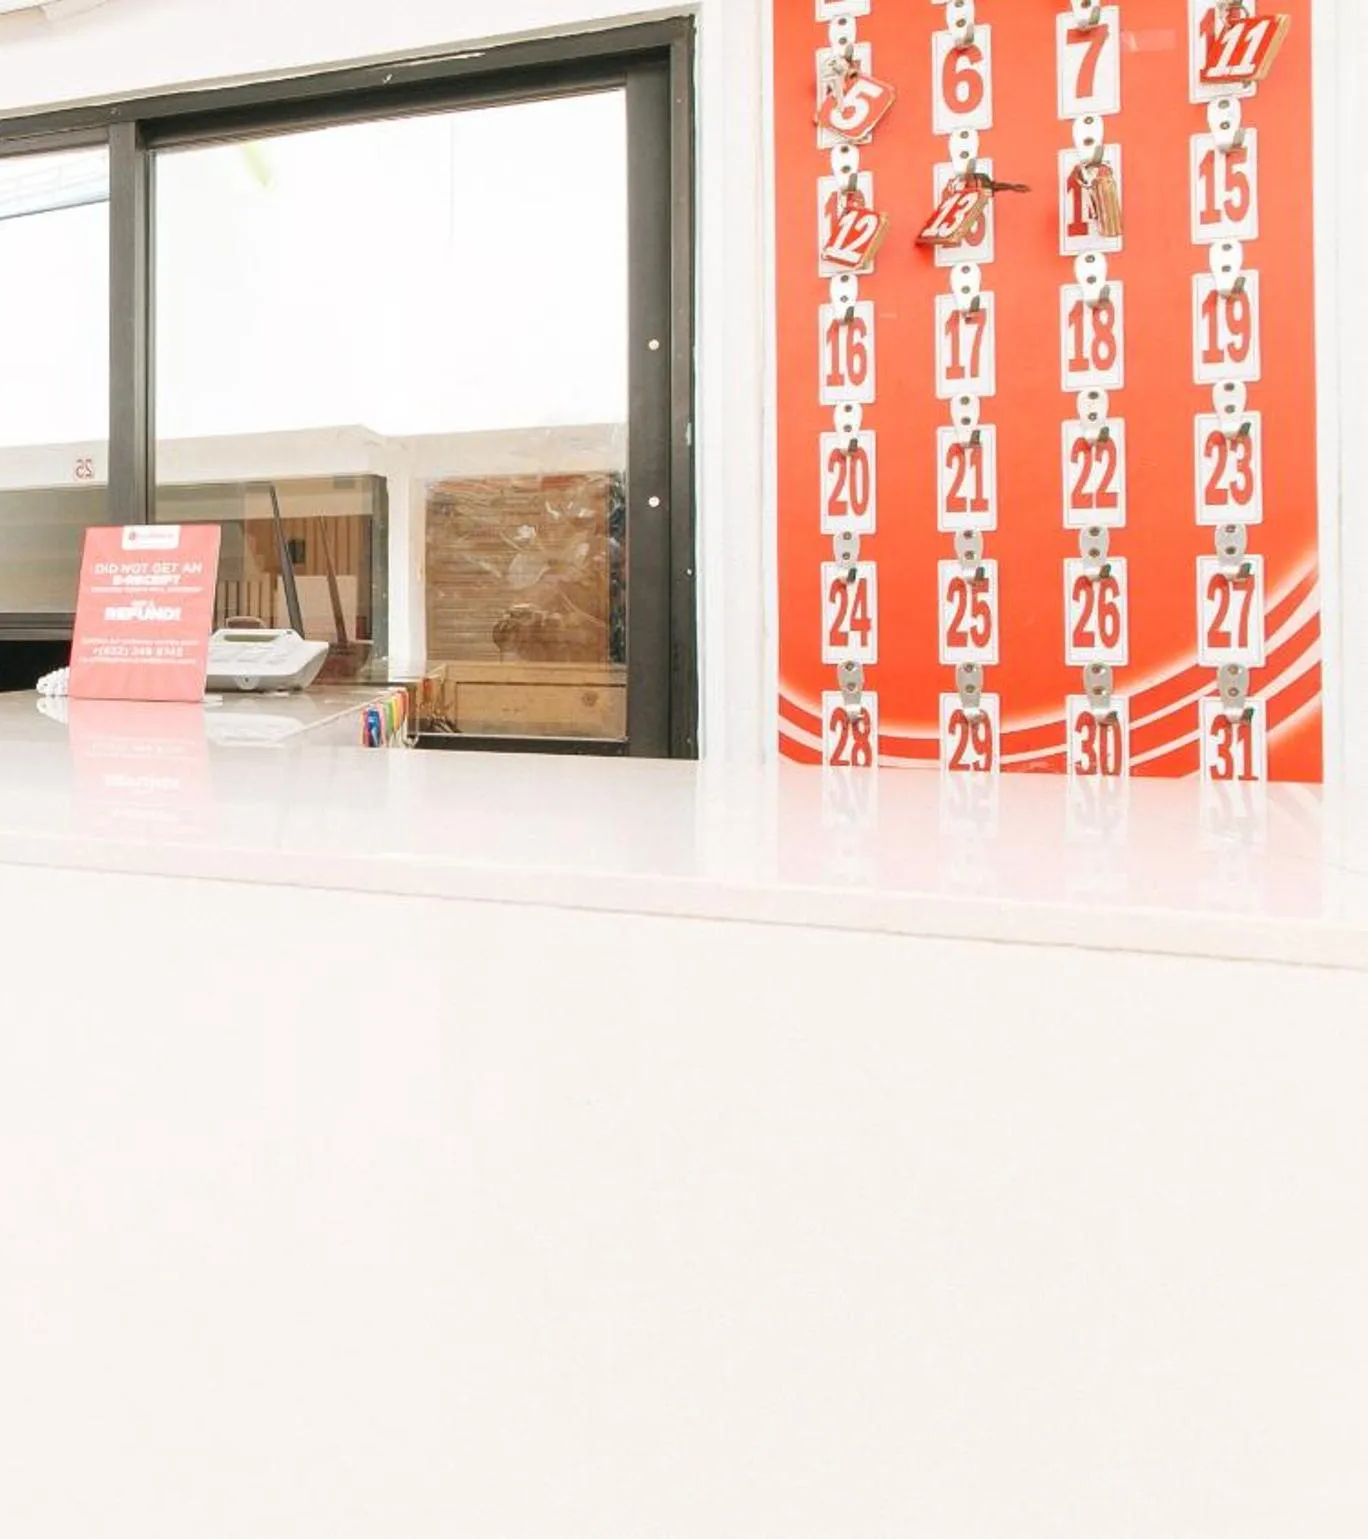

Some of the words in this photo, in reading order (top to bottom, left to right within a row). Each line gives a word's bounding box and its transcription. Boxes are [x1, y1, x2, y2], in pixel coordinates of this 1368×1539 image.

[941, 45, 984, 114] 6
[1066, 24, 1109, 99] 7
[1206, 18, 1271, 78] 11
[828, 78, 884, 130] 5
[920, 189, 979, 238] 13
[1199, 147, 1250, 225] 15
[824, 209, 879, 264] 12
[825, 318, 868, 387] 16
[944, 309, 987, 380] 17
[1069, 301, 1117, 372] 18
[1202, 290, 1251, 364] 19
[827, 447, 870, 517] 20
[945, 442, 989, 513] 21
[1069, 436, 1119, 510] 22
[1204, 431, 1255, 506] 23
[828, 577, 872, 648] 24
[945, 576, 992, 649] 25
[1072, 575, 1122, 650] 26
[1206, 573, 1257, 649] 27
[829, 707, 873, 767] 28
[948, 708, 993, 773] 29
[1074, 711, 1122, 776] 30
[1210, 713, 1259, 781] 31
